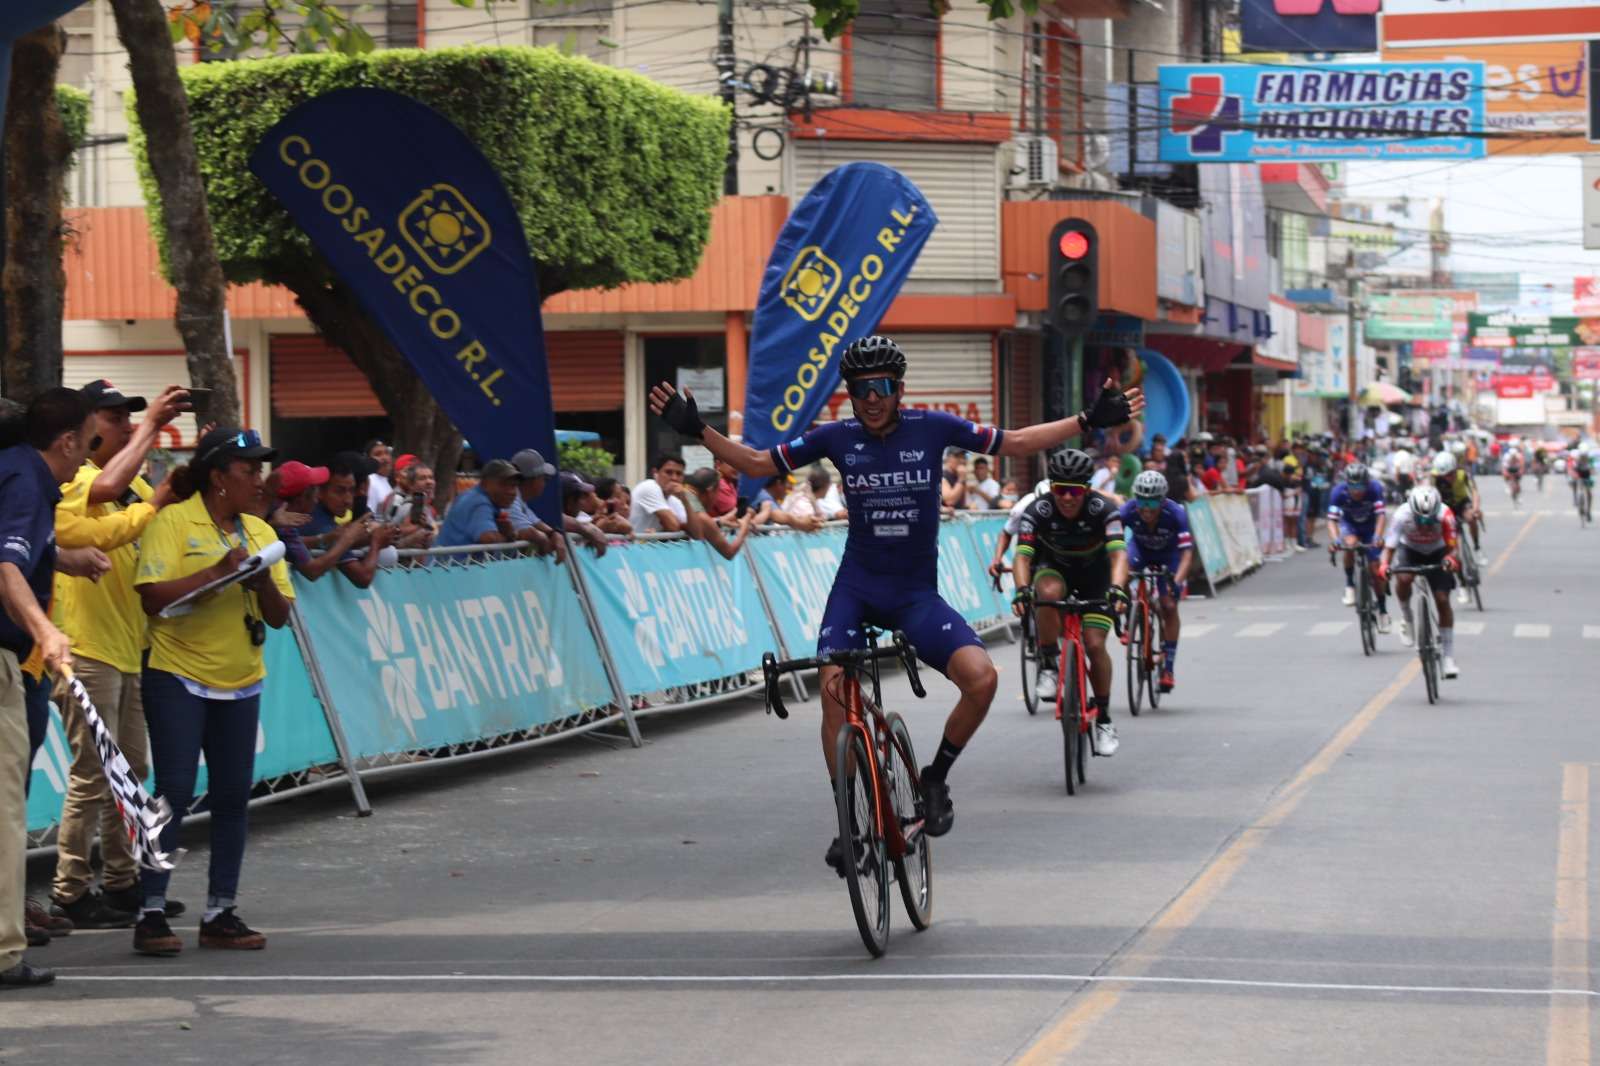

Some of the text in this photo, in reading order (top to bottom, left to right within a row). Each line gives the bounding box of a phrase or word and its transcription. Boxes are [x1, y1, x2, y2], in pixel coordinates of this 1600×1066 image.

[1256, 108, 1470, 140] NACIONALES
[1257, 71, 1470, 103] FARMACIAS
[279, 135, 505, 407] COOSADECO R.L.
[771, 254, 884, 432] COOSADECO
[877, 204, 919, 253] R.L.
[846, 468, 931, 488] CASTELLI
[405, 590, 564, 710] BANTRAB
